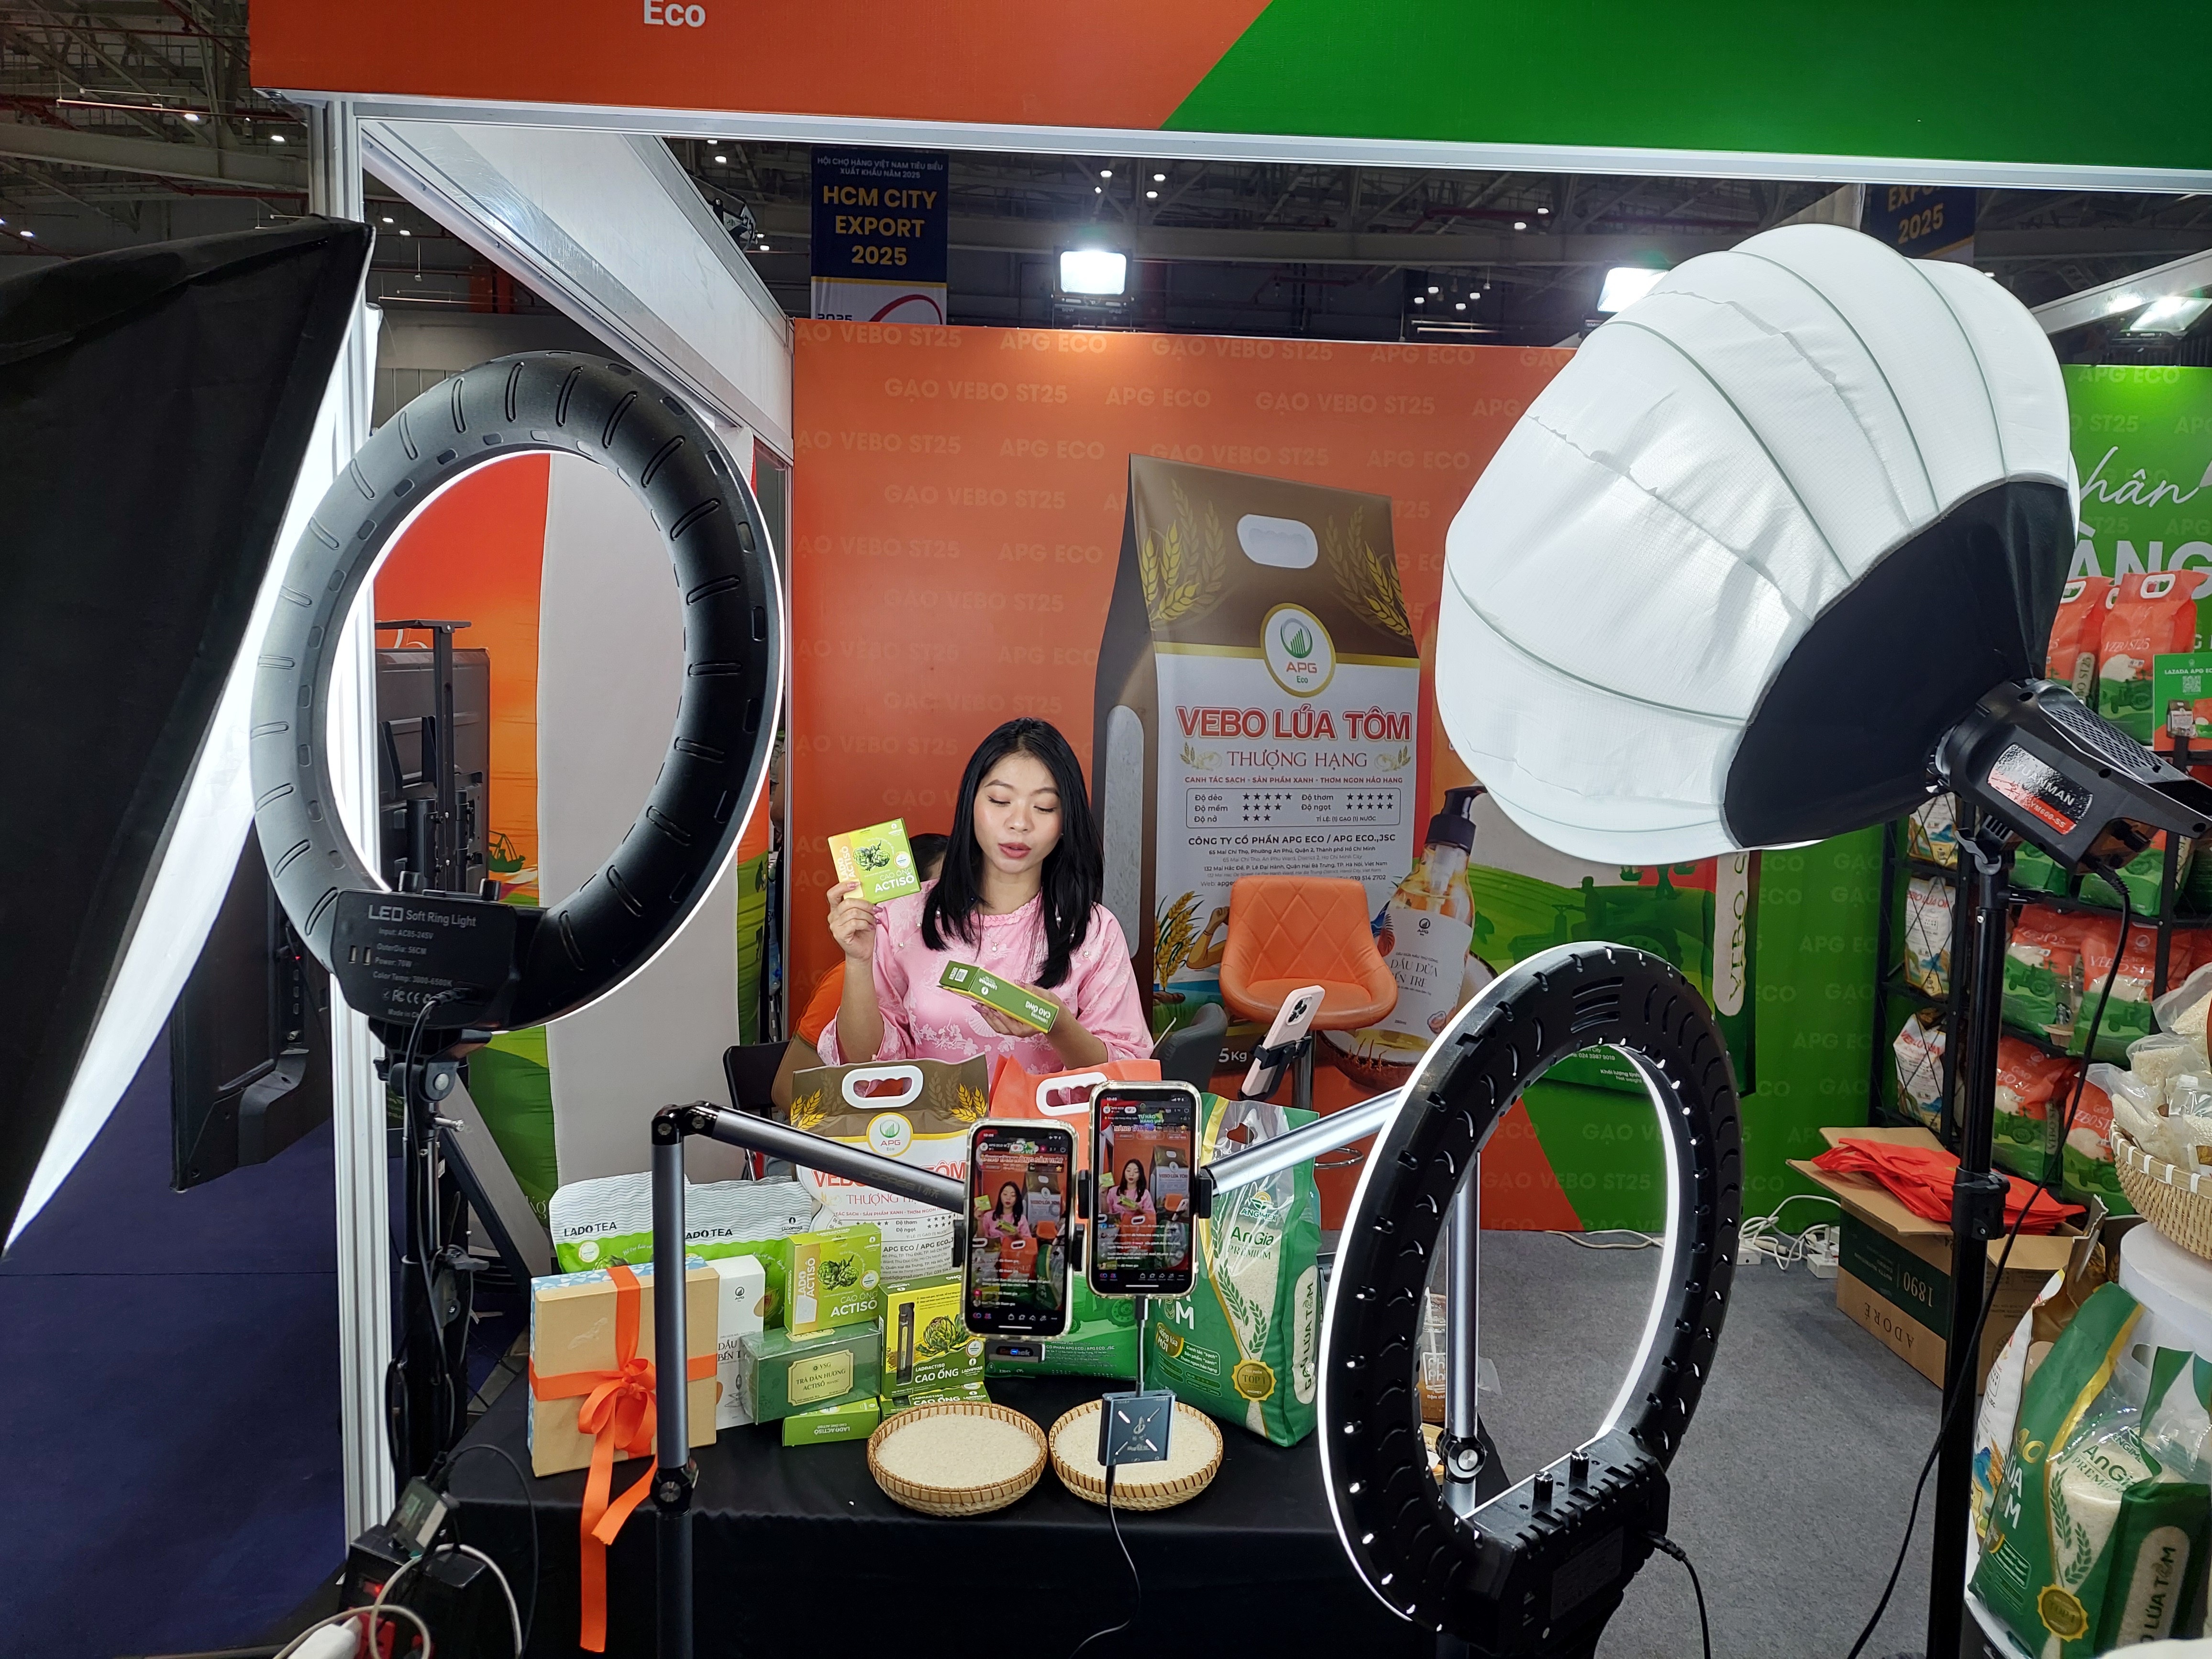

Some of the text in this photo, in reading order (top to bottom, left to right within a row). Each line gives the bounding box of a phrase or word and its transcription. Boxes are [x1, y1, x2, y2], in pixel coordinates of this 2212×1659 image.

[643, 0, 705, 27] Eco
[818, 156, 830, 166] HỘI
[851, 158, 872, 166] HÀNG
[874, 159, 889, 169] VIỆT
[823, 186, 937, 209] HCM CITY
[835, 215, 925, 238] EXPORT
[1898, 202, 1944, 245] 2025
[851, 245, 907, 265] 2025
[841, 325, 1476, 365] VEBO ST25 APG ECO GẠO VEBO ST25 APG ECO
[2078, 367, 2180, 384] APG ECO
[885, 378, 940, 402] GẠO
[948, 381, 1008, 401] VEBO
[1016, 384, 1068, 404] ST25
[1106, 387, 1154, 406] APG
[1163, 389, 1210, 408] ECO
[1318, 394, 1377, 413] VEBO
[1385, 395, 1435, 414] ST25
[2090, 414, 2139, 432] ST25
[1000, 439, 1105, 459] APG ECO
[1286, 662, 1317, 674] APG
[1296, 675, 1308, 684] Eco
[1177, 704, 1412, 741] VEBO LÚA TÔM
[1227, 749, 1367, 770] THƯỢNG HẠNG
[1195, 794, 1206, 802] Độ
[1194, 805, 1206, 813] Độ
[2031, 801, 2066, 828] YM600-SS
[1188, 836, 1217, 845] CÔNG
[1235, 835, 1249, 844] CỔ
[1252, 834, 1279, 844] PHẦN
[1355, 834, 1395, 842] ECO.,JSC
[874, 873, 915, 893] ACTISÔ
[368, 905, 476, 928] LED Soft Ring Light
[1410, 975, 1427, 987] TRE
[1540, 1172, 1596, 1189] VEBO
[1603, 1172, 1651, 1190] ST25
[846, 1194, 899, 1207] THƯỢNG
[564, 1221, 617, 1237] LADO TEA
[711, 1228, 733, 1237] TEA
[1228, 1245, 1271, 1260] PREMIUM
[806, 1258, 815, 1296] ACTISÔ
[1903, 1272, 1933, 1307] 1890
[830, 1297, 878, 1317] ACTISÔ
[841, 1294, 858, 1304] CAO
[718, 1339, 737, 1351] DẦU
[718, 1350, 734, 1361] BẾN
[915, 1368, 959, 1383] CAO ỐNG
[1243, 1374, 1260, 1382] TOP
